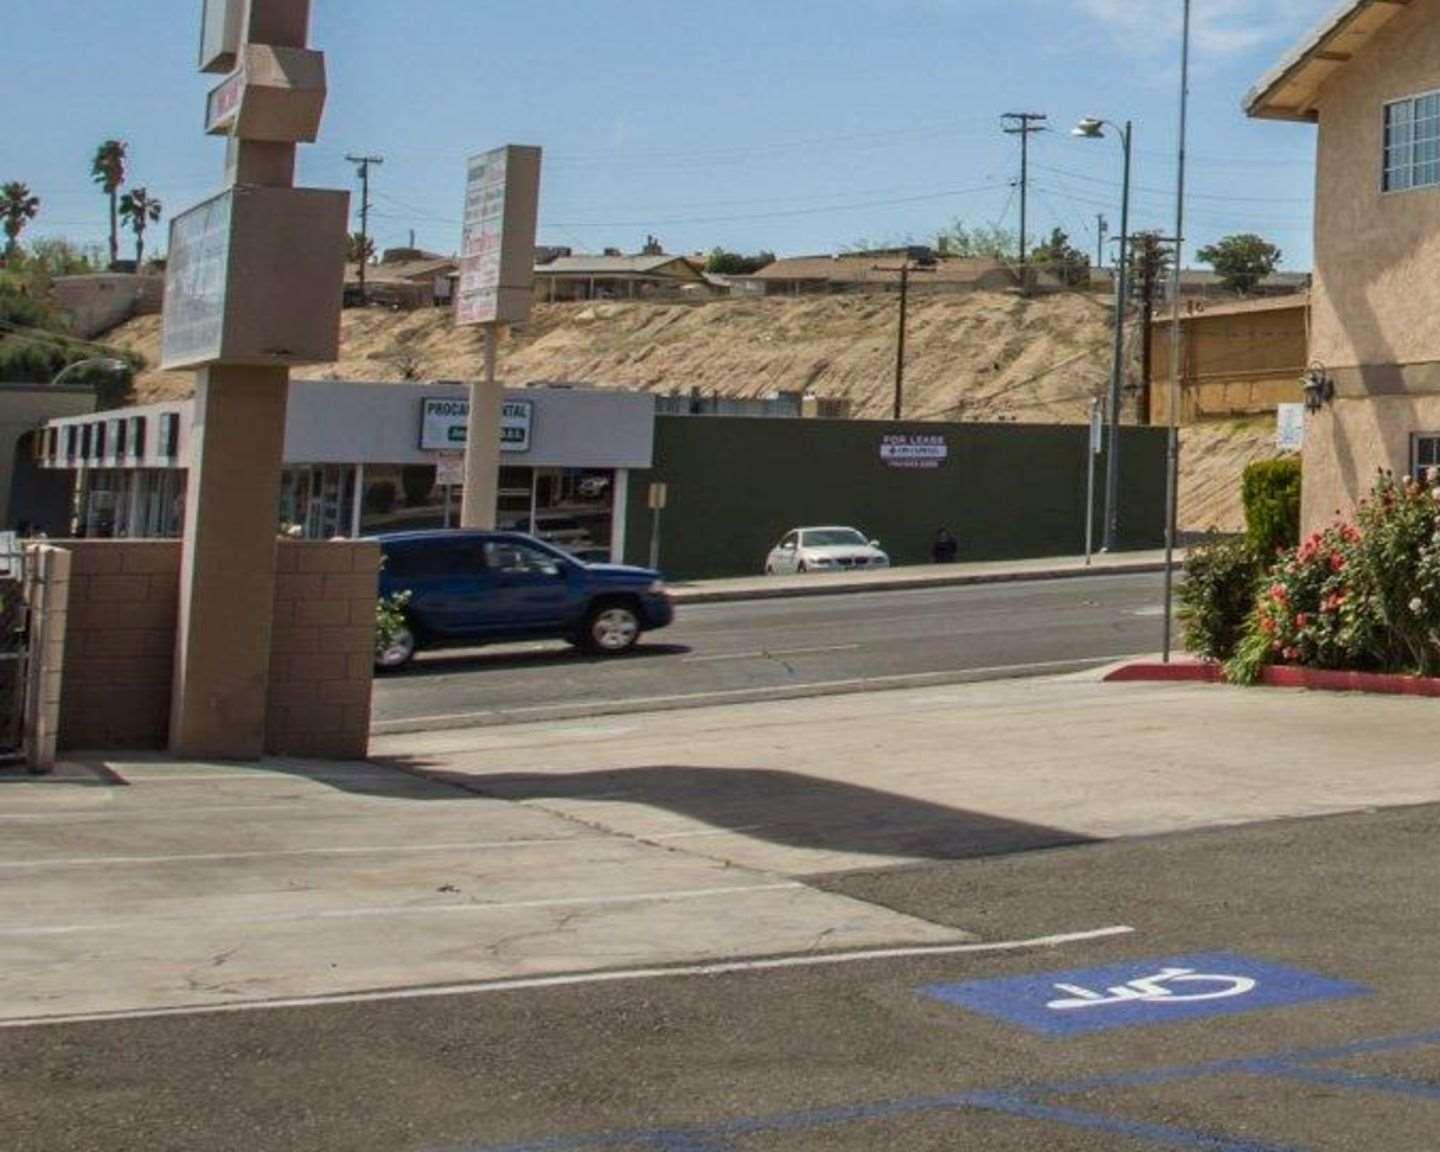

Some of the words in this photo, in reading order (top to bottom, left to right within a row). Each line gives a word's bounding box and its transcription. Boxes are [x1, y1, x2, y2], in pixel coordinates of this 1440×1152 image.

[427, 402, 469, 417] PROCA
[883, 435, 906, 445] FOR
[910, 435, 945, 445] LEASE
